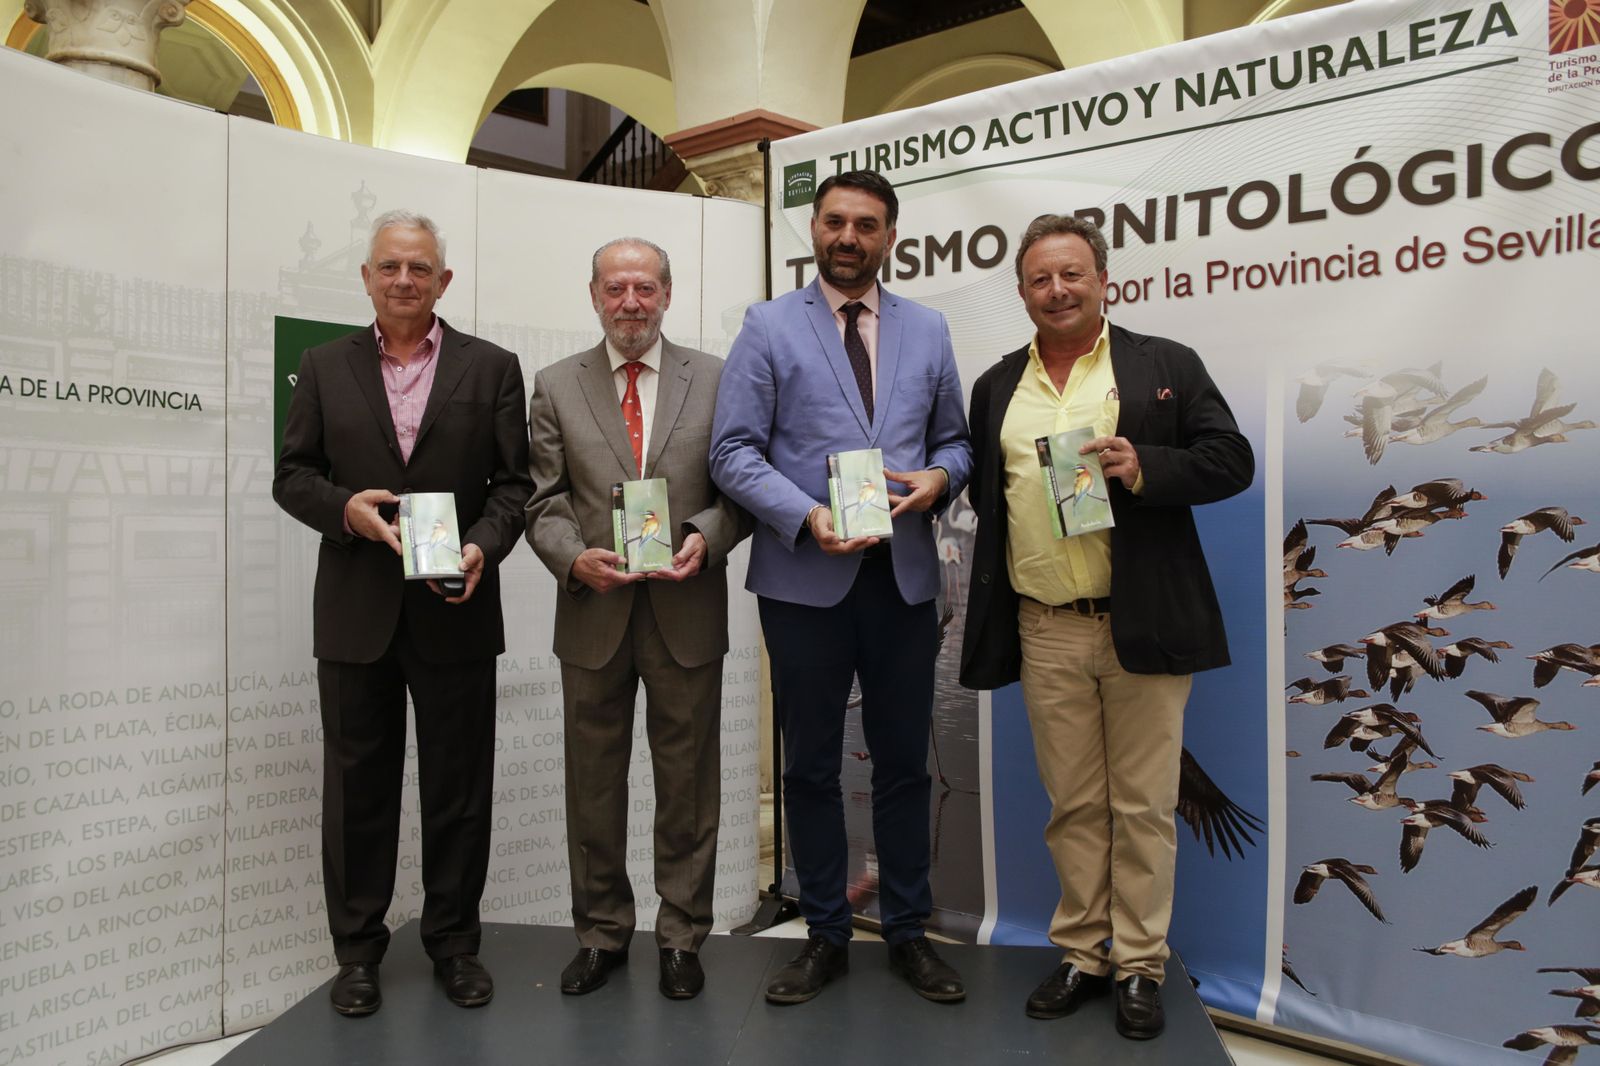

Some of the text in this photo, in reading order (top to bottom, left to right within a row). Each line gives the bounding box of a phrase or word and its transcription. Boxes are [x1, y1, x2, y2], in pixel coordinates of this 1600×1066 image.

[830, 2, 1518, 177] TURISMO ACTIVO Y NATURALEZA
[1548, 73, 1562, 83] de
[1568, 69, 1578, 79] la
[1550, 54, 1597, 71] Turismo
[789, 186, 812, 197] SEVILLA
[786, 224, 1008, 290] TISMO
[1103, 276, 1153, 314] por
[1165, 267, 1193, 298] la
[1206, 242, 1382, 293] Provincia
[1395, 235, 1446, 273] de
[20, 377, 48, 398] DE
[55, 381, 80, 402] LA
[88, 384, 203, 412] PROVINCIA
[29, 697, 52, 714] LA
[59, 690, 118, 711] RODA
[126, 687, 152, 704] DE
[158, 671, 273, 701] ANDALUCÍA,
[529, 656, 544, 671] EL
[29, 729, 55, 749] DE
[63, 726, 87, 744] LA
[95, 719, 157, 740] PLATA,
[165, 712, 222, 733] ÉCIJA,
[229, 700, 304, 723] CAÑADA
[44, 754, 133, 780] TOCINA,
[141, 737, 257, 767] VILLANUEVA
[265, 732, 294, 749] DEL
[34, 788, 130, 815] CAZALLA,
[136, 767, 248, 800] ALGÁMITAS,
[255, 758, 317, 780] PRUNA,
[513, 736, 528, 749] EL
[82, 815, 157, 841] ESTEPA,
[165, 801, 238, 826] GILENA,
[247, 787, 322, 811] PEDRERA,
[501, 761, 528, 777] LOS
[68, 856, 105, 877] LOS
[113, 836, 204, 868] PALACIOS
[210, 833, 221, 849] Y
[520, 786, 538, 801] DE
[14, 896, 64, 920] VISO
[73, 886, 110, 908] DEL
[118, 870, 188, 899] ALCOR,
[195, 852, 278, 882] MAIRENA
[284, 844, 313, 862] DEL
[68, 923, 91, 942] LA
[98, 895, 223, 935] RINCONADA,
[231, 877, 299, 903] SEVILLA,
[496, 836, 555, 857] GERENA,
[0, 960, 76, 997] PUEBLA
[84, 948, 120, 971] DEL
[128, 936, 167, 960] RÍO,
[174, 905, 300, 948] AZNALCÁZAR,
[26, 981, 117, 1022] ARISCAL,
[125, 947, 241, 991] ESPARTINAS,
[481, 885, 561, 913] BOLLULLOS
[86, 1040, 128, 1066] SAN
[140, 1009, 230, 1050] NICOLÁS
[241, 998, 274, 1020] DEL
[116, 1002, 151, 1026] DEL
[158, 979, 235, 1012] CAMPO,
[243, 972, 261, 988] EL
